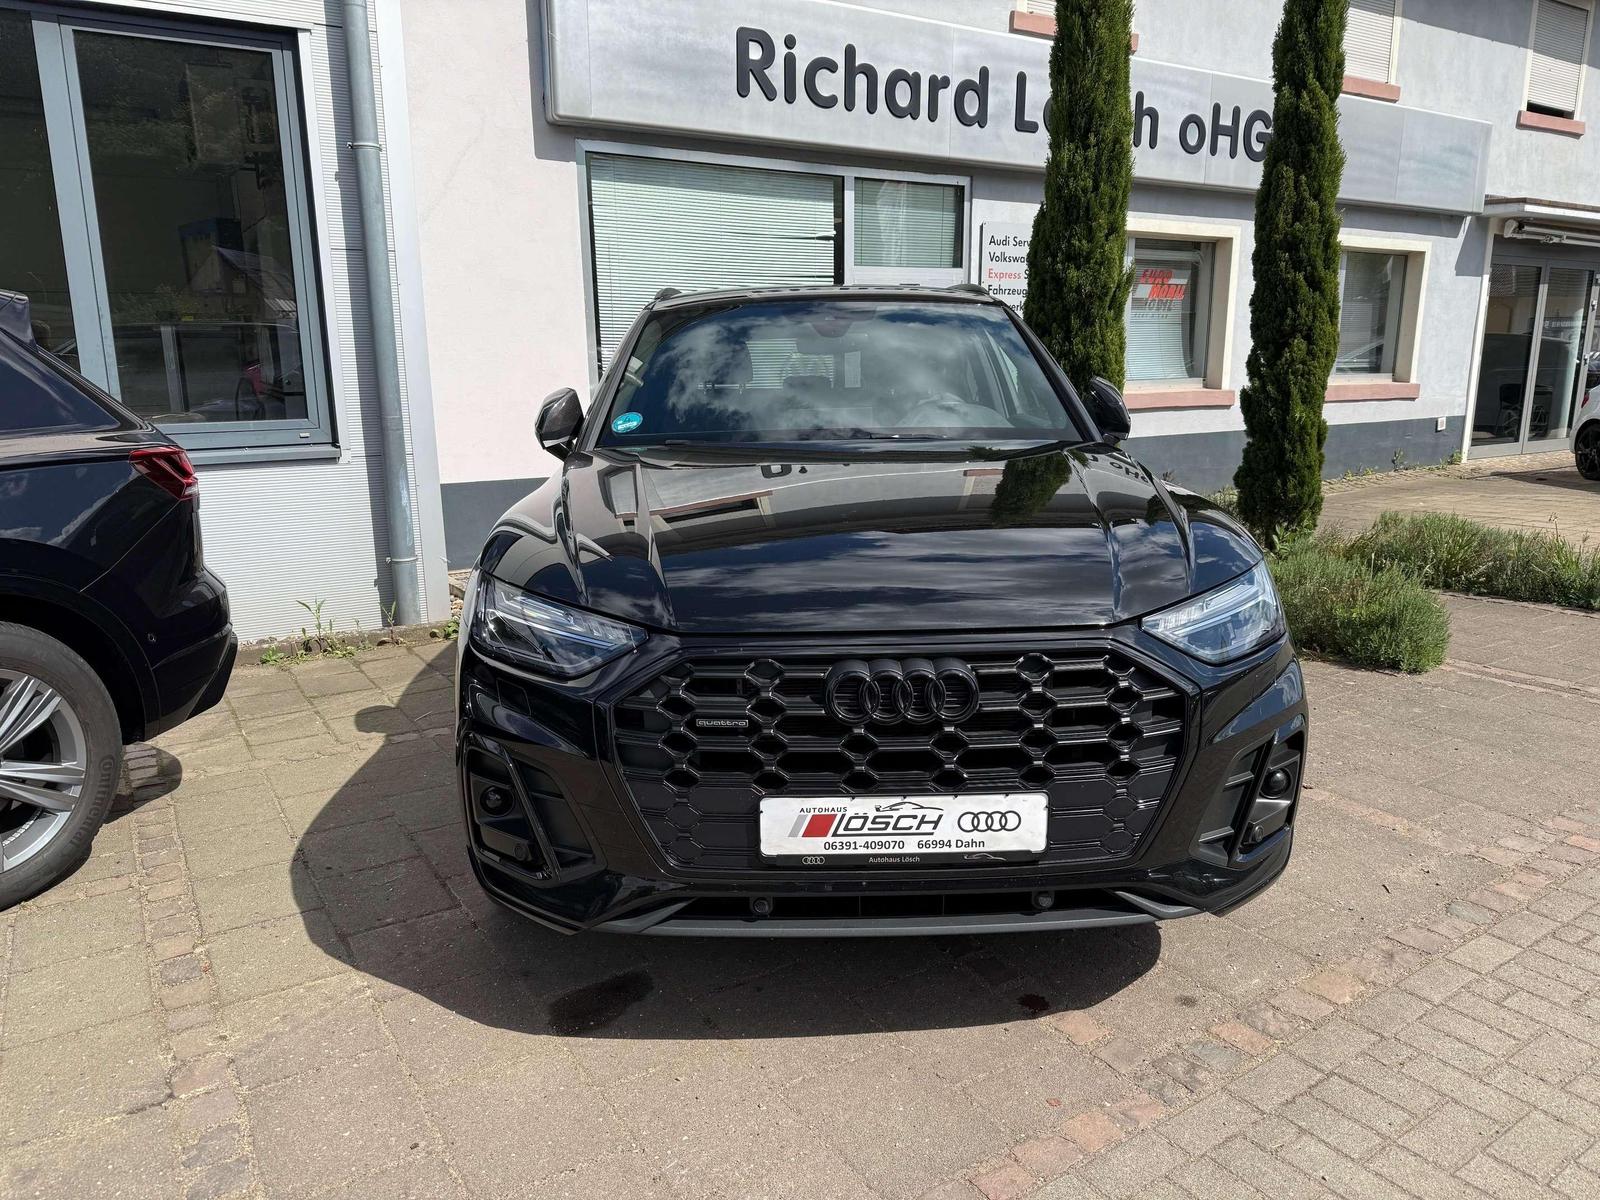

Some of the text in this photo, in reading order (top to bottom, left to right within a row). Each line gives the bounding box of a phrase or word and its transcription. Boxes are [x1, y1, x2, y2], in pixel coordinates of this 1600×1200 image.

[736, 26, 990, 129] Richard
[1179, 102, 1274, 162] oHG
[988, 235, 1010, 246] Audi
[988, 268, 1021, 281] Express
[987, 284, 1027, 298] Fahrzeug
[697, 719, 747, 727] quattro
[799, 806, 848, 814] AUTOHAUS
[831, 812, 944, 837] LÖSCH
[823, 838, 986, 852] 06391-409070 66994 Dahn
[868, 855, 920, 863] Autohaus Lösch
